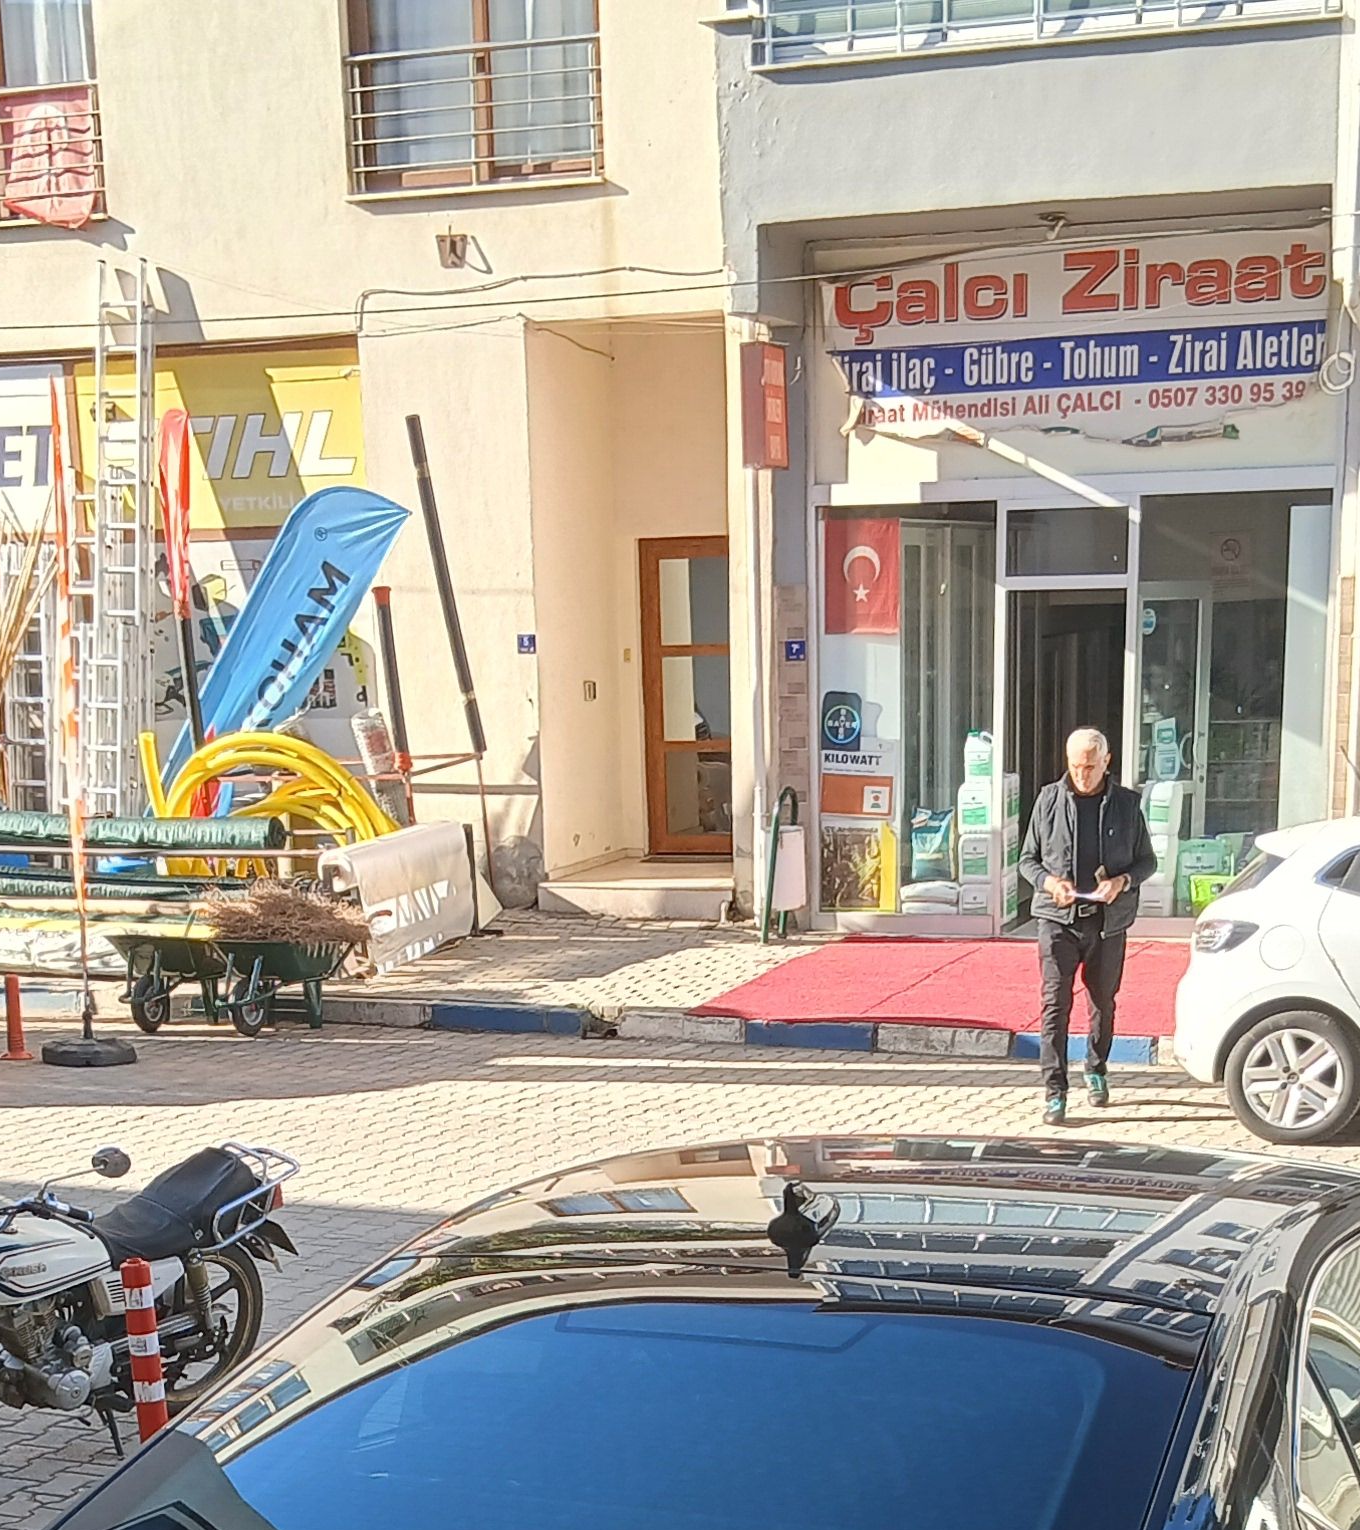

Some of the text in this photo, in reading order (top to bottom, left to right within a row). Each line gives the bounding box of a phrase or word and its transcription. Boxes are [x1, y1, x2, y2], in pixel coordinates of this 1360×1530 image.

[835, 243, 1327, 344] Çalcı Ziraat
[833, 353, 883, 393] irai
[963, 346, 1034, 388] Gübre
[1060, 340, 1139, 380] Tohum
[1168, 333, 1227, 374] Zirai
[912, 398, 1016, 423] Mühendisi
[1023, 394, 1050, 416] Ali
[1056, 390, 1121, 419] ÇALCI
[1148, 386, 1198, 409] 0507
[1204, 383, 1242, 406] 330
[1249, 382, 1275, 402] 95
[824, 753, 881, 765] KILOWATT
